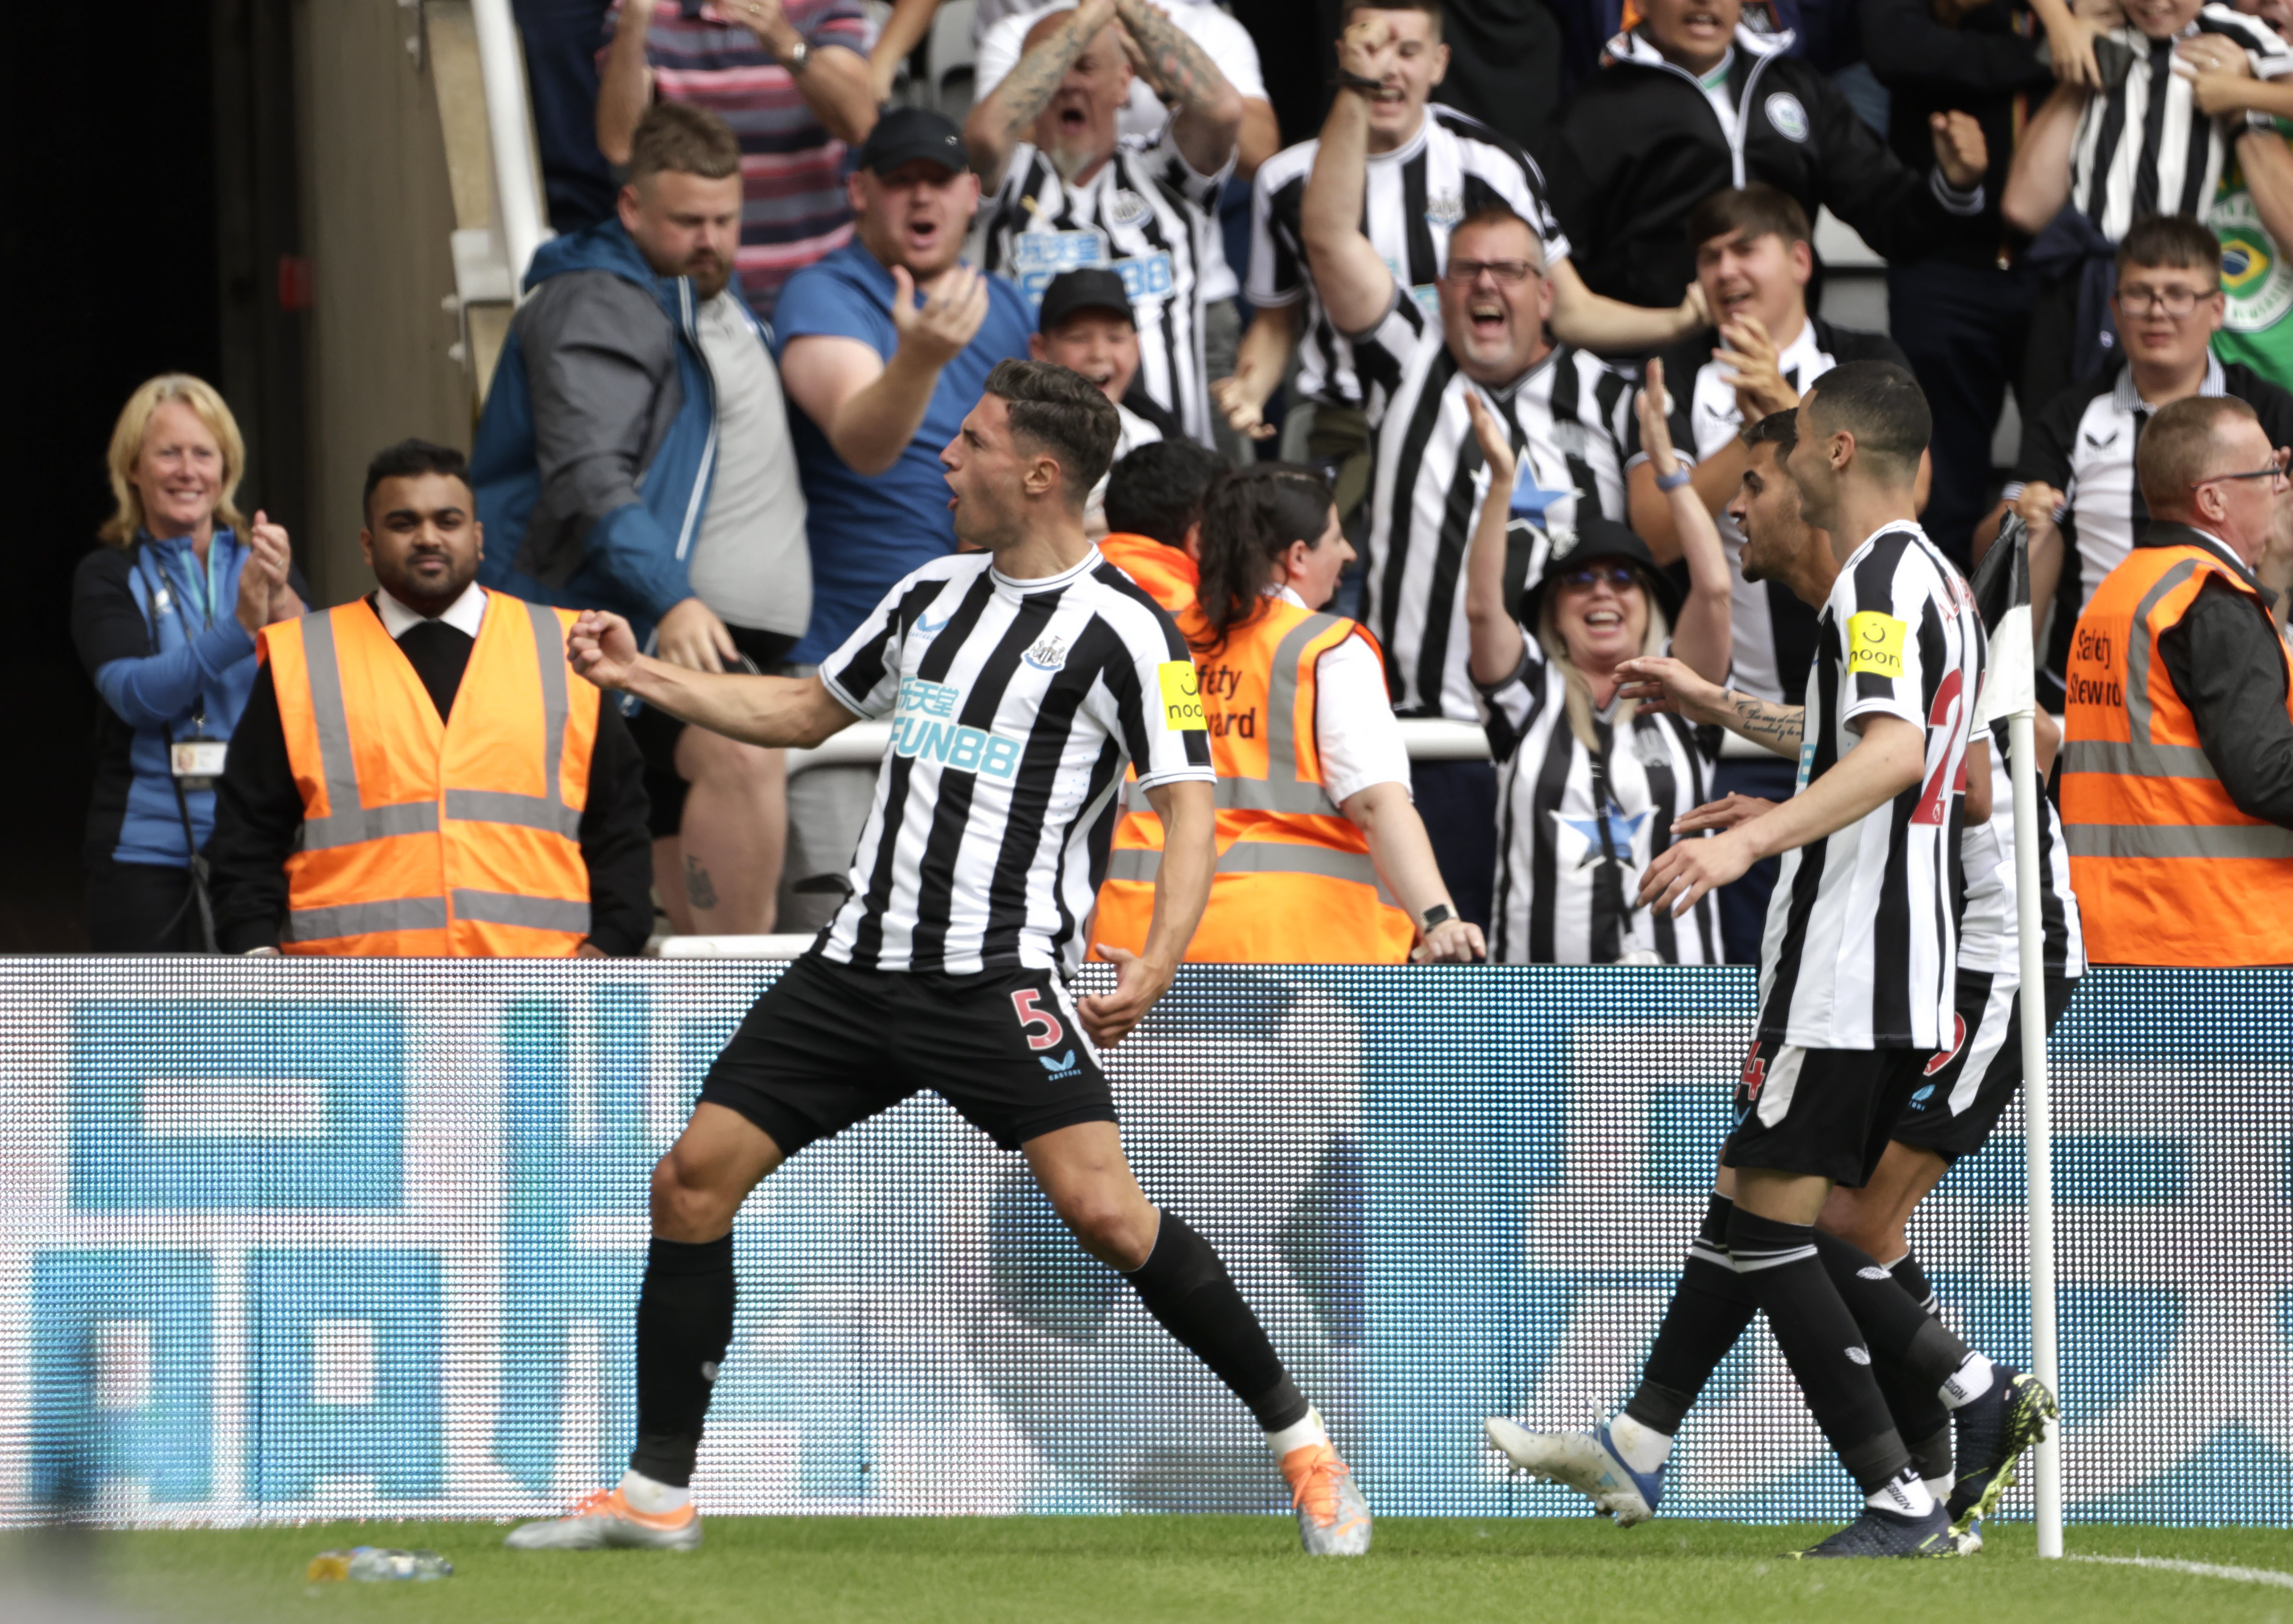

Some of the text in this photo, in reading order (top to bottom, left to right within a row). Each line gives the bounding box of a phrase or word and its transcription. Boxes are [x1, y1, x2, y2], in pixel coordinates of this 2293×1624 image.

[1849, 649, 1900, 668] noon
[1196, 665, 1242, 701] fety
[1168, 704, 1203, 719] noo
[1010, 988, 1063, 1050] 5
